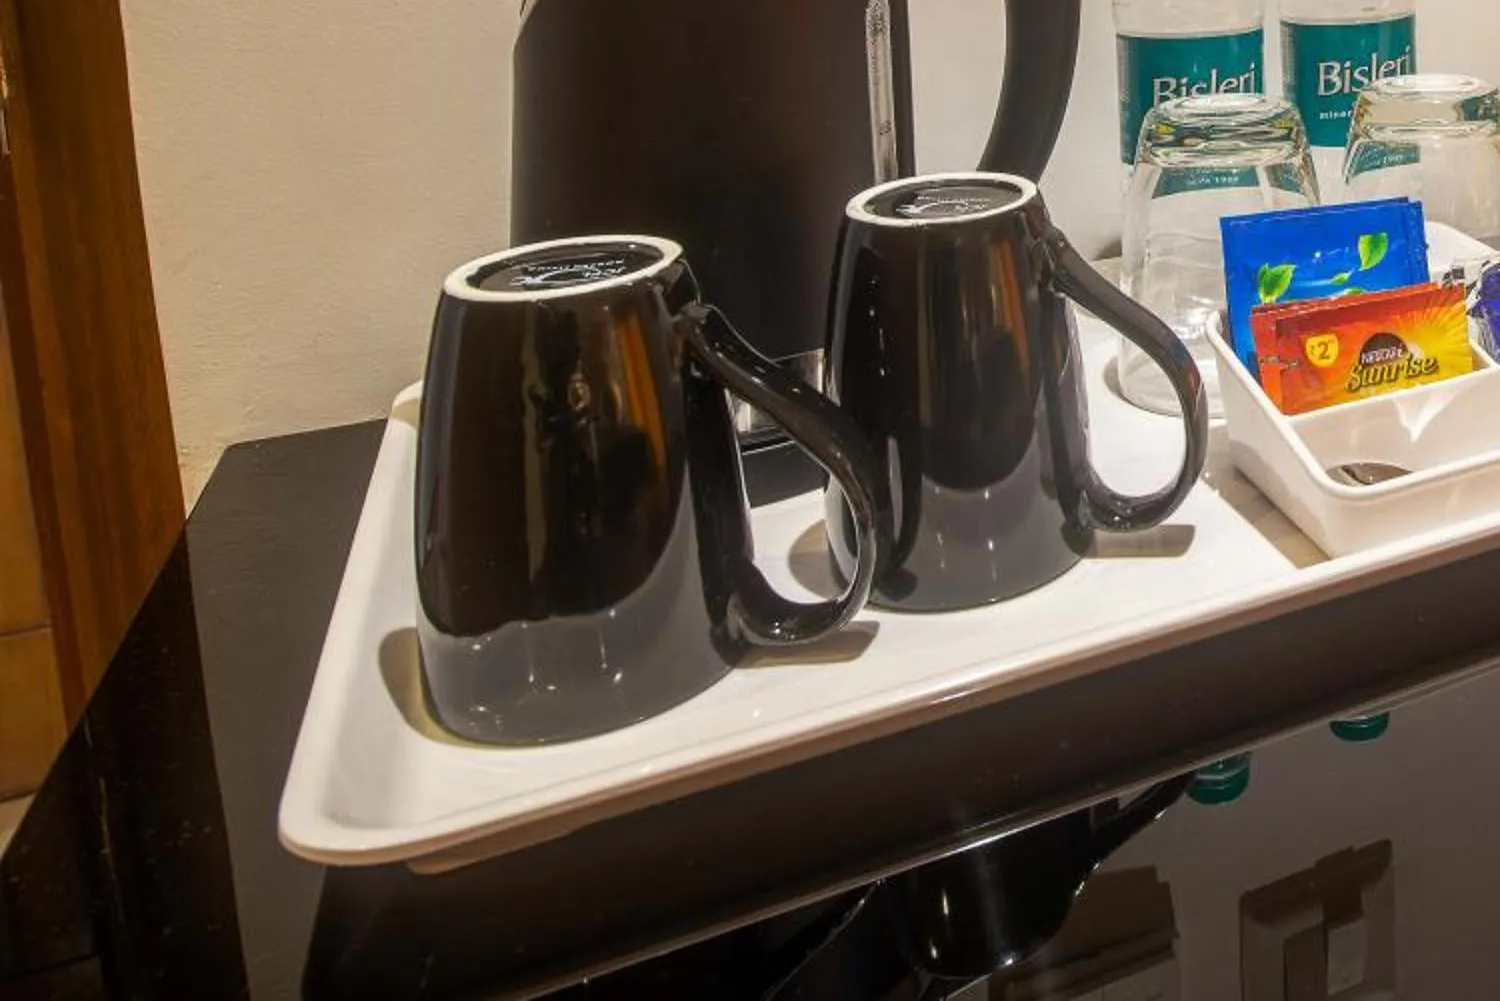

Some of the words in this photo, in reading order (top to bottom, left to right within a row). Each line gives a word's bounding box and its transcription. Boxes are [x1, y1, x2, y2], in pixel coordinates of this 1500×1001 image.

[1152, 63, 1256, 106] Bisleri
[1317, 44, 1412, 97] Bisleri
[1346, 355, 1439, 393] Sunrise
